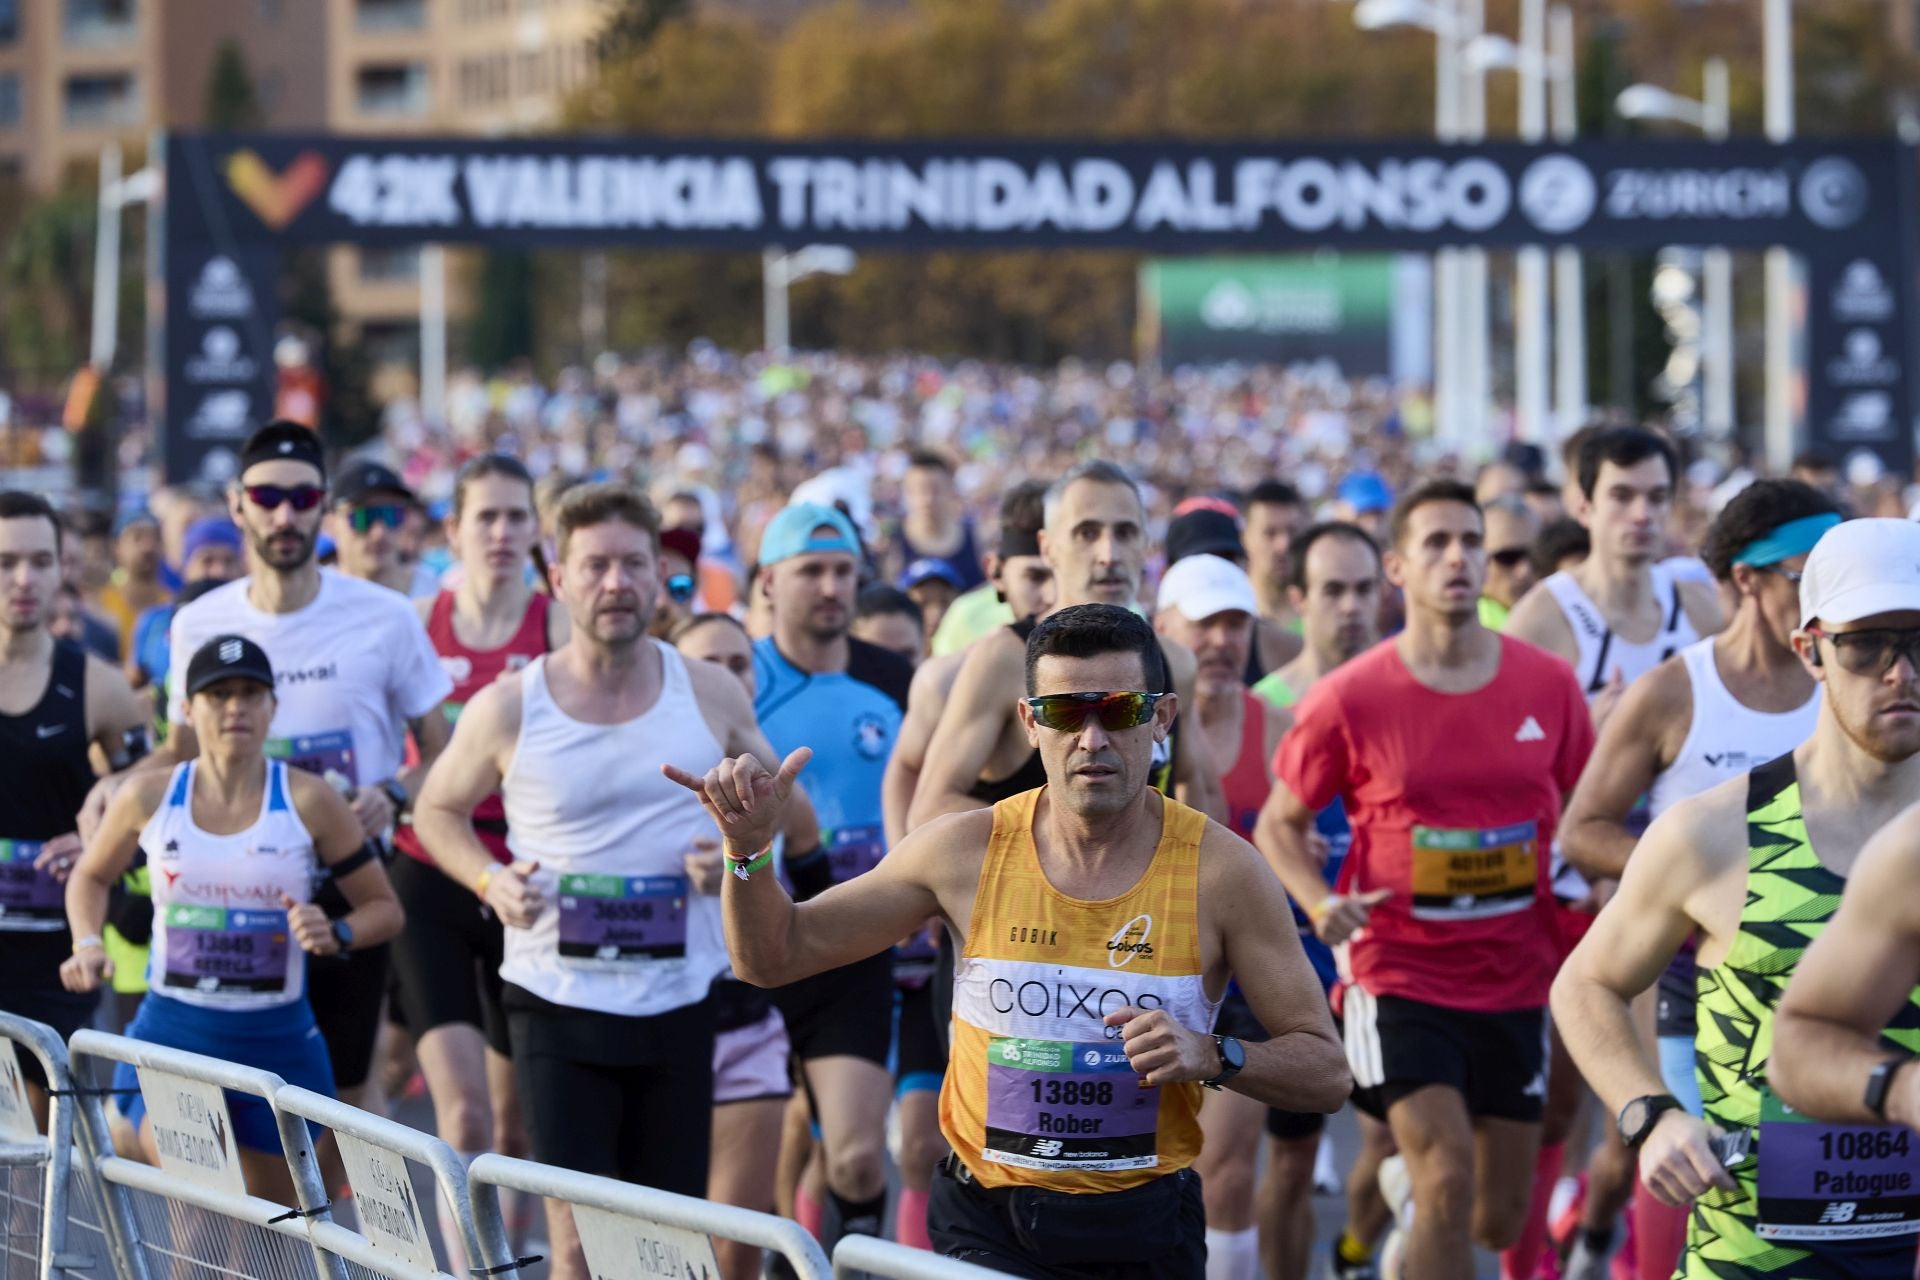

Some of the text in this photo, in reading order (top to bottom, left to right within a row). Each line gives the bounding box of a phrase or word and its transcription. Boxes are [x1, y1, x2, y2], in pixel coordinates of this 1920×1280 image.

[330, 155, 1790, 232] 42K VALENCIA TRINIDAD ALFONSO ZURICH
[1010, 927, 1058, 946] GOBIK
[1023, 1050, 1060, 1060] TRINIDAD
[1023, 1058, 1060, 1067] ALFONSO
[1104, 1054, 1129, 1063] ZUR
[1031, 1079, 1113, 1105] 13898
[1039, 1112, 1103, 1134] Rober
[1819, 1130, 1910, 1160] 10864
[1814, 1170, 1911, 1197] Patogue
